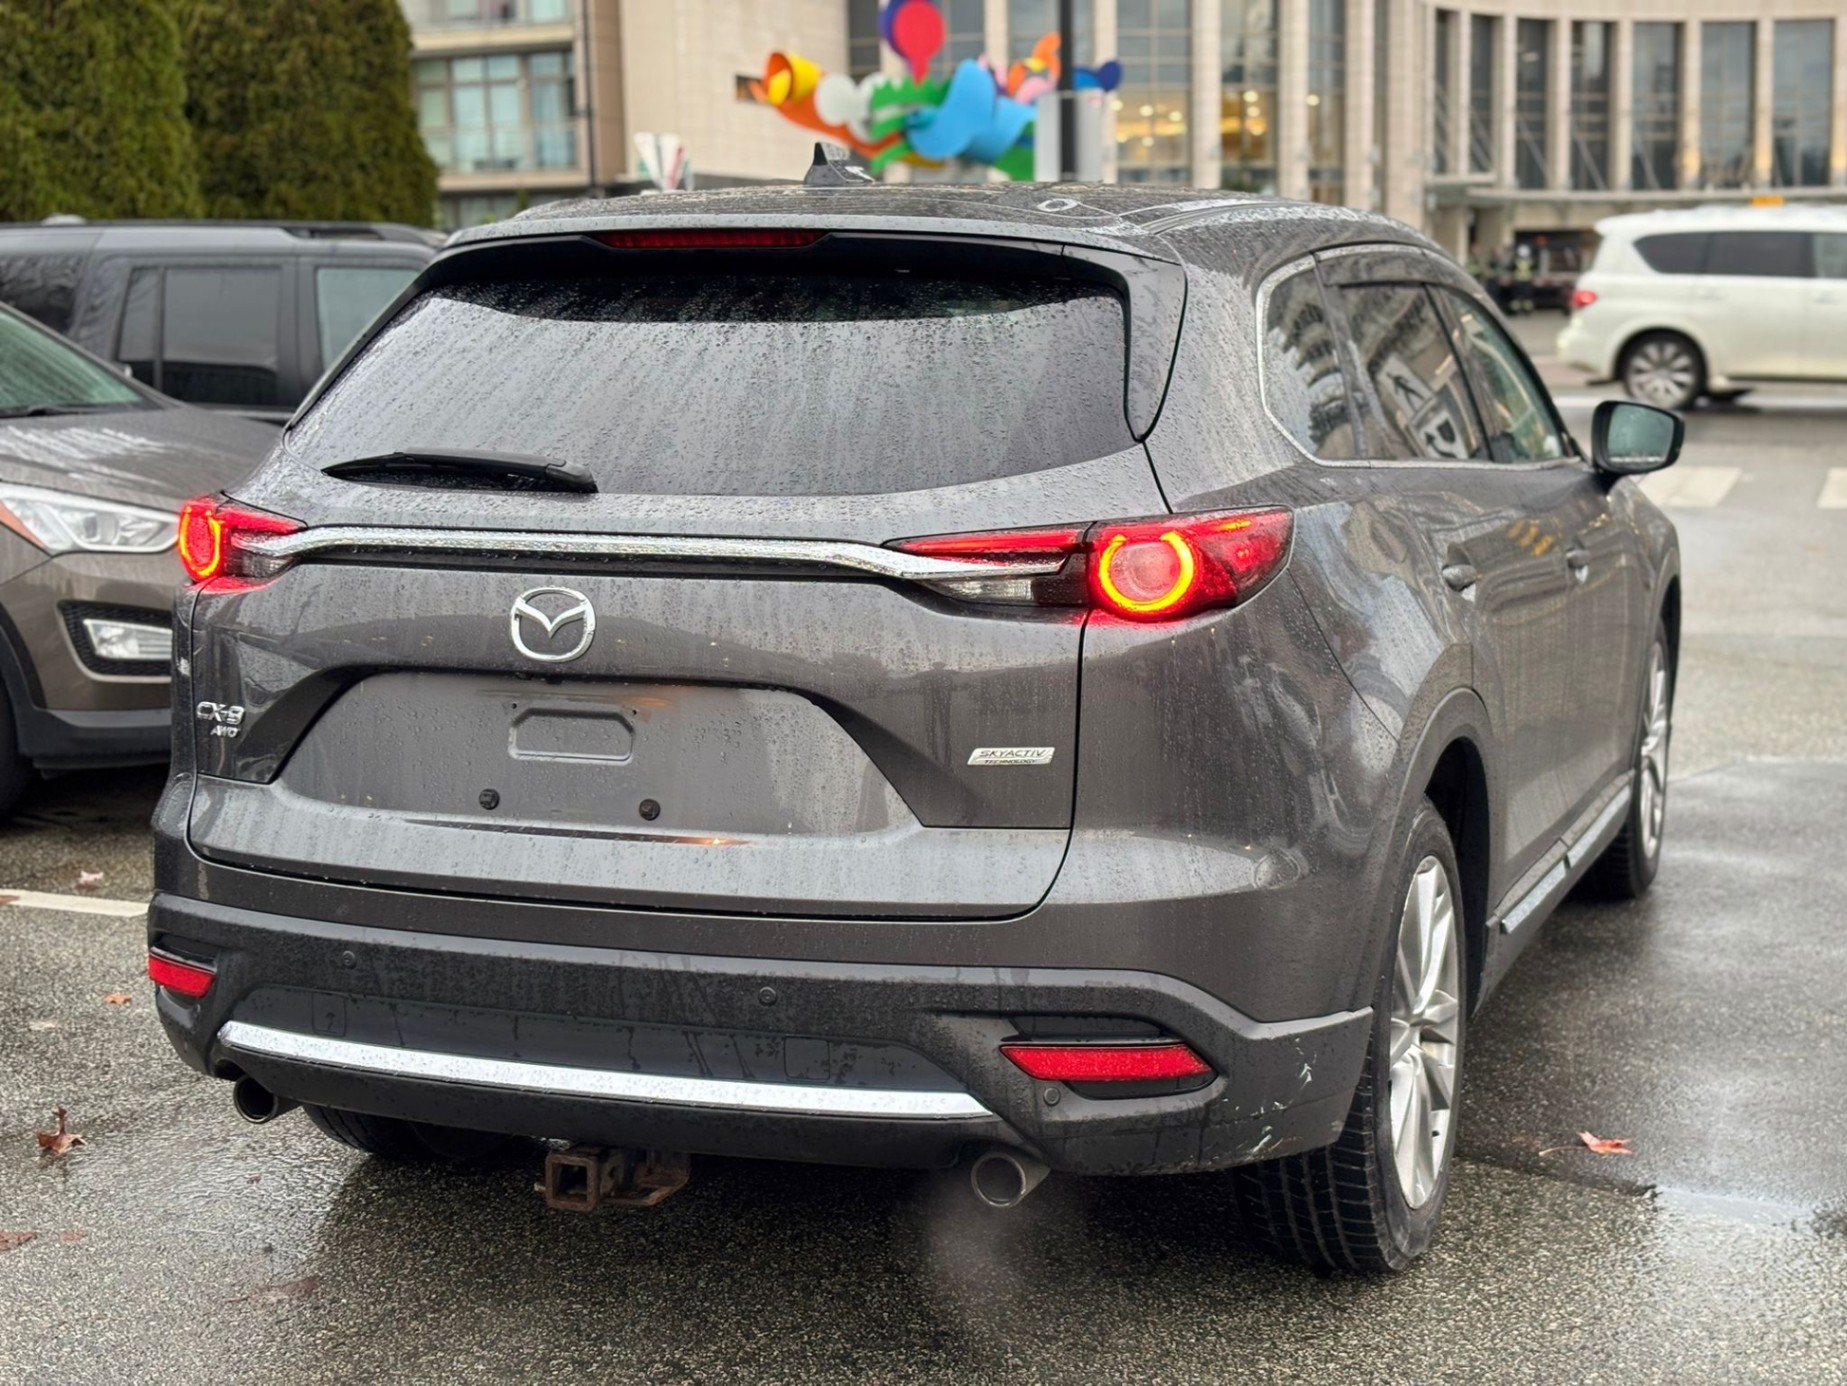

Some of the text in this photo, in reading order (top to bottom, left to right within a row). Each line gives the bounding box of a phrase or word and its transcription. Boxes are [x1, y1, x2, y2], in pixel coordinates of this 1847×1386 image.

[196, 701, 245, 725] CX-9
[210, 725, 239, 738] AWD
[979, 749, 1047, 757] SKYACTIV
